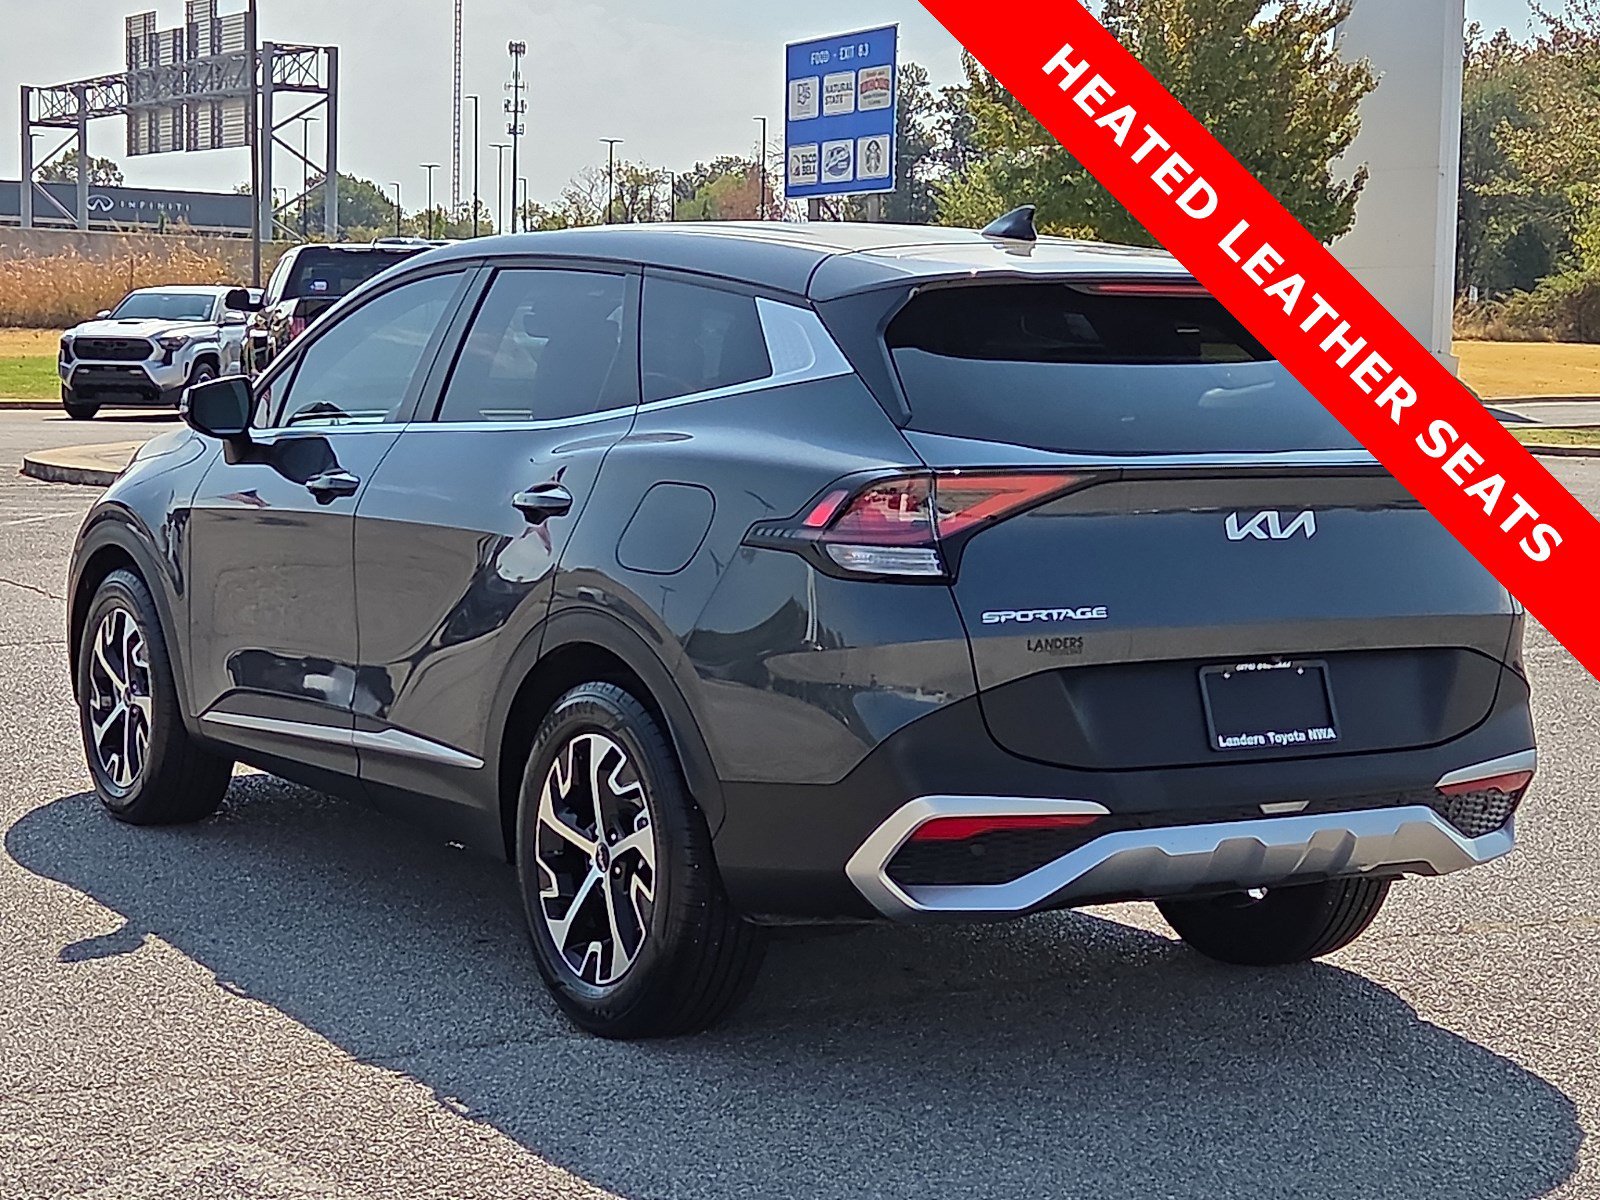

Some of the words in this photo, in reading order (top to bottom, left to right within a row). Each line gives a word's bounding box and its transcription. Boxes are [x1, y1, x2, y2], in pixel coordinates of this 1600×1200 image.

[811, 50, 830, 65] FOOD
[839, 45, 855, 61] EXIT
[825, 81, 853, 94] NATURAL
[825, 94, 843, 106] STATE
[801, 153, 817, 164] TACO
[802, 164, 817, 176] BELL
[120, 200, 191, 212] INFINITI
[982, 606, 1108, 624] SPORTAGE
[1027, 637, 1084, 652] LANDERS
[1218, 734, 1266, 748] Landers
[1267, 730, 1306, 745] Toyota
[1308, 727, 1337, 741] NWA
